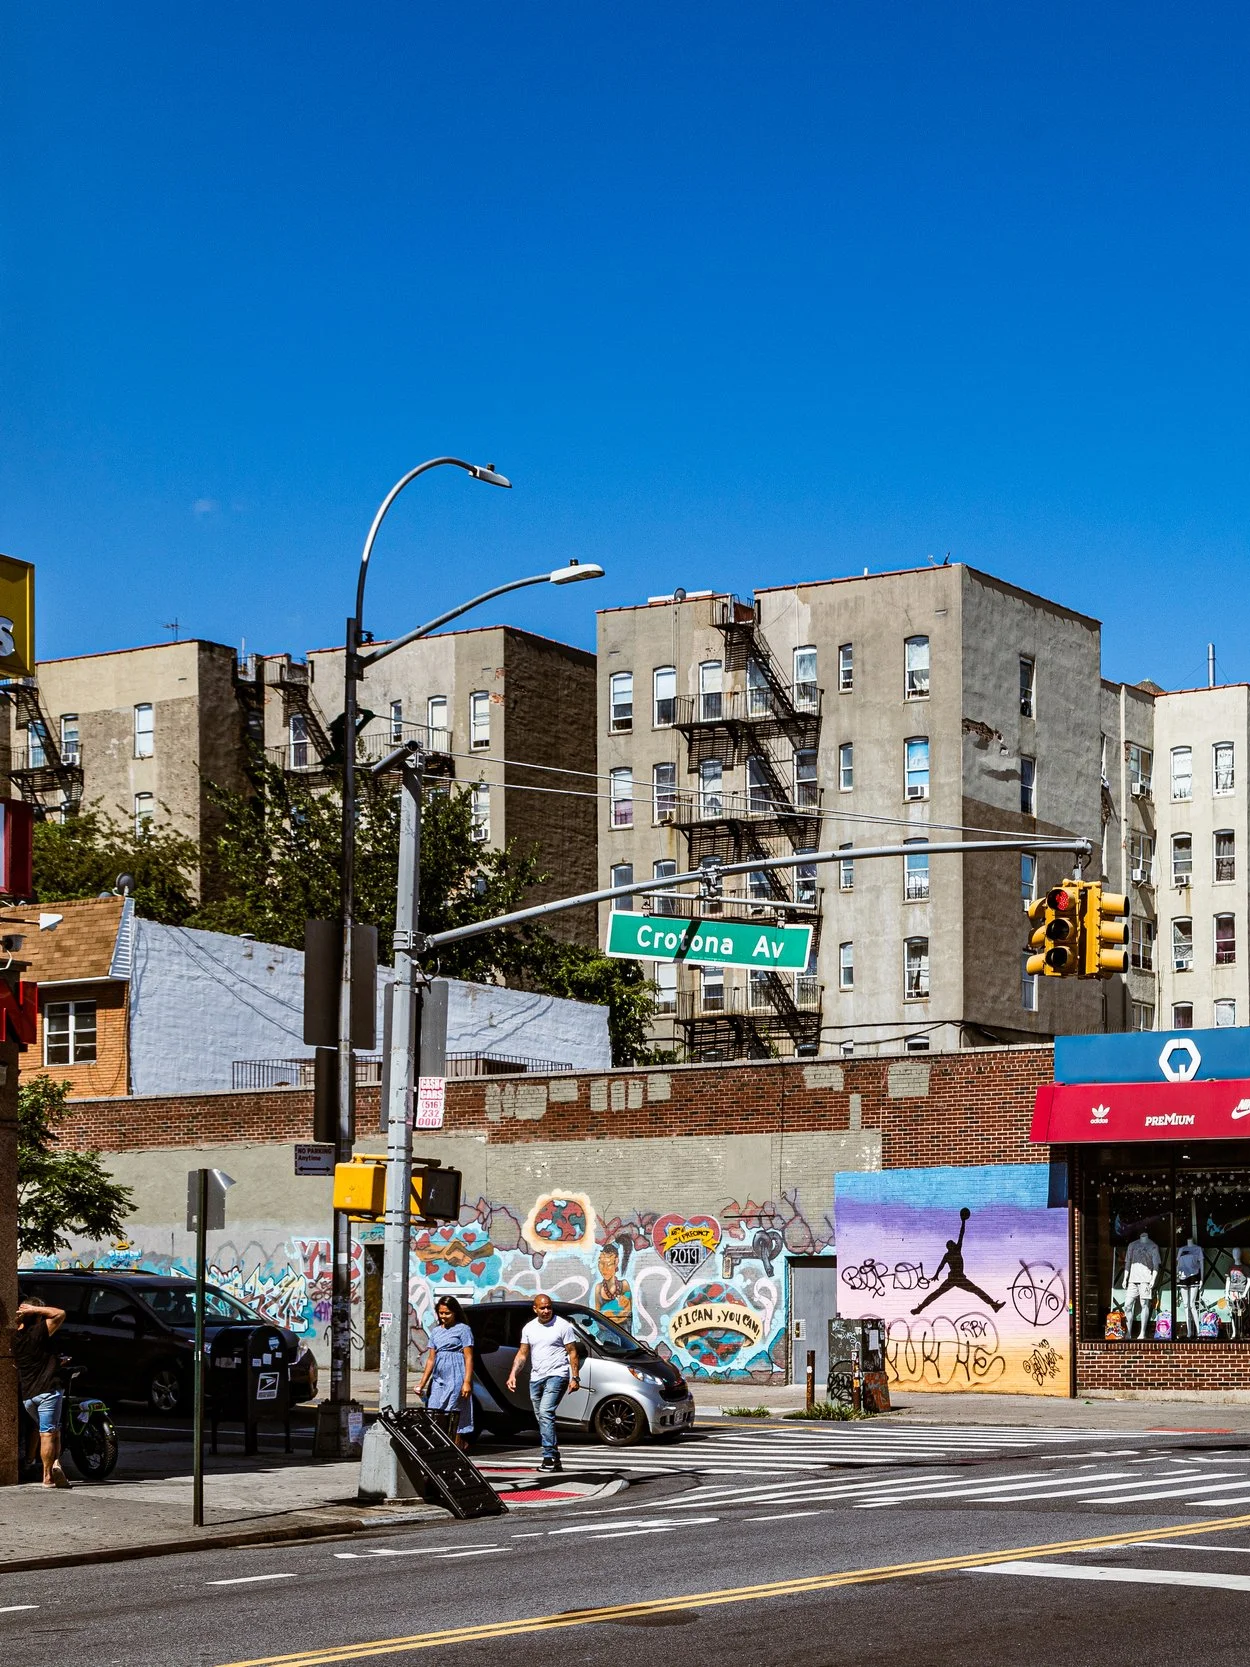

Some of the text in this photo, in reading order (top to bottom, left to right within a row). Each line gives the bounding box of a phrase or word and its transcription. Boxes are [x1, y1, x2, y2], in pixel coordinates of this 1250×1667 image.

[636, 924, 785, 959] Crotona Av
[420, 1090, 443, 1099] CARS
[421, 1100, 442, 1109] (516)
[422, 1109, 440, 1118] 232
[1145, 1112, 1195, 1127] PREMIUM
[418, 1117, 441, 1126] 0007
[671, 1248, 697, 1264] 2019
[721, 1310, 741, 1325] YOU
[741, 1314, 760, 1340] CAN!
